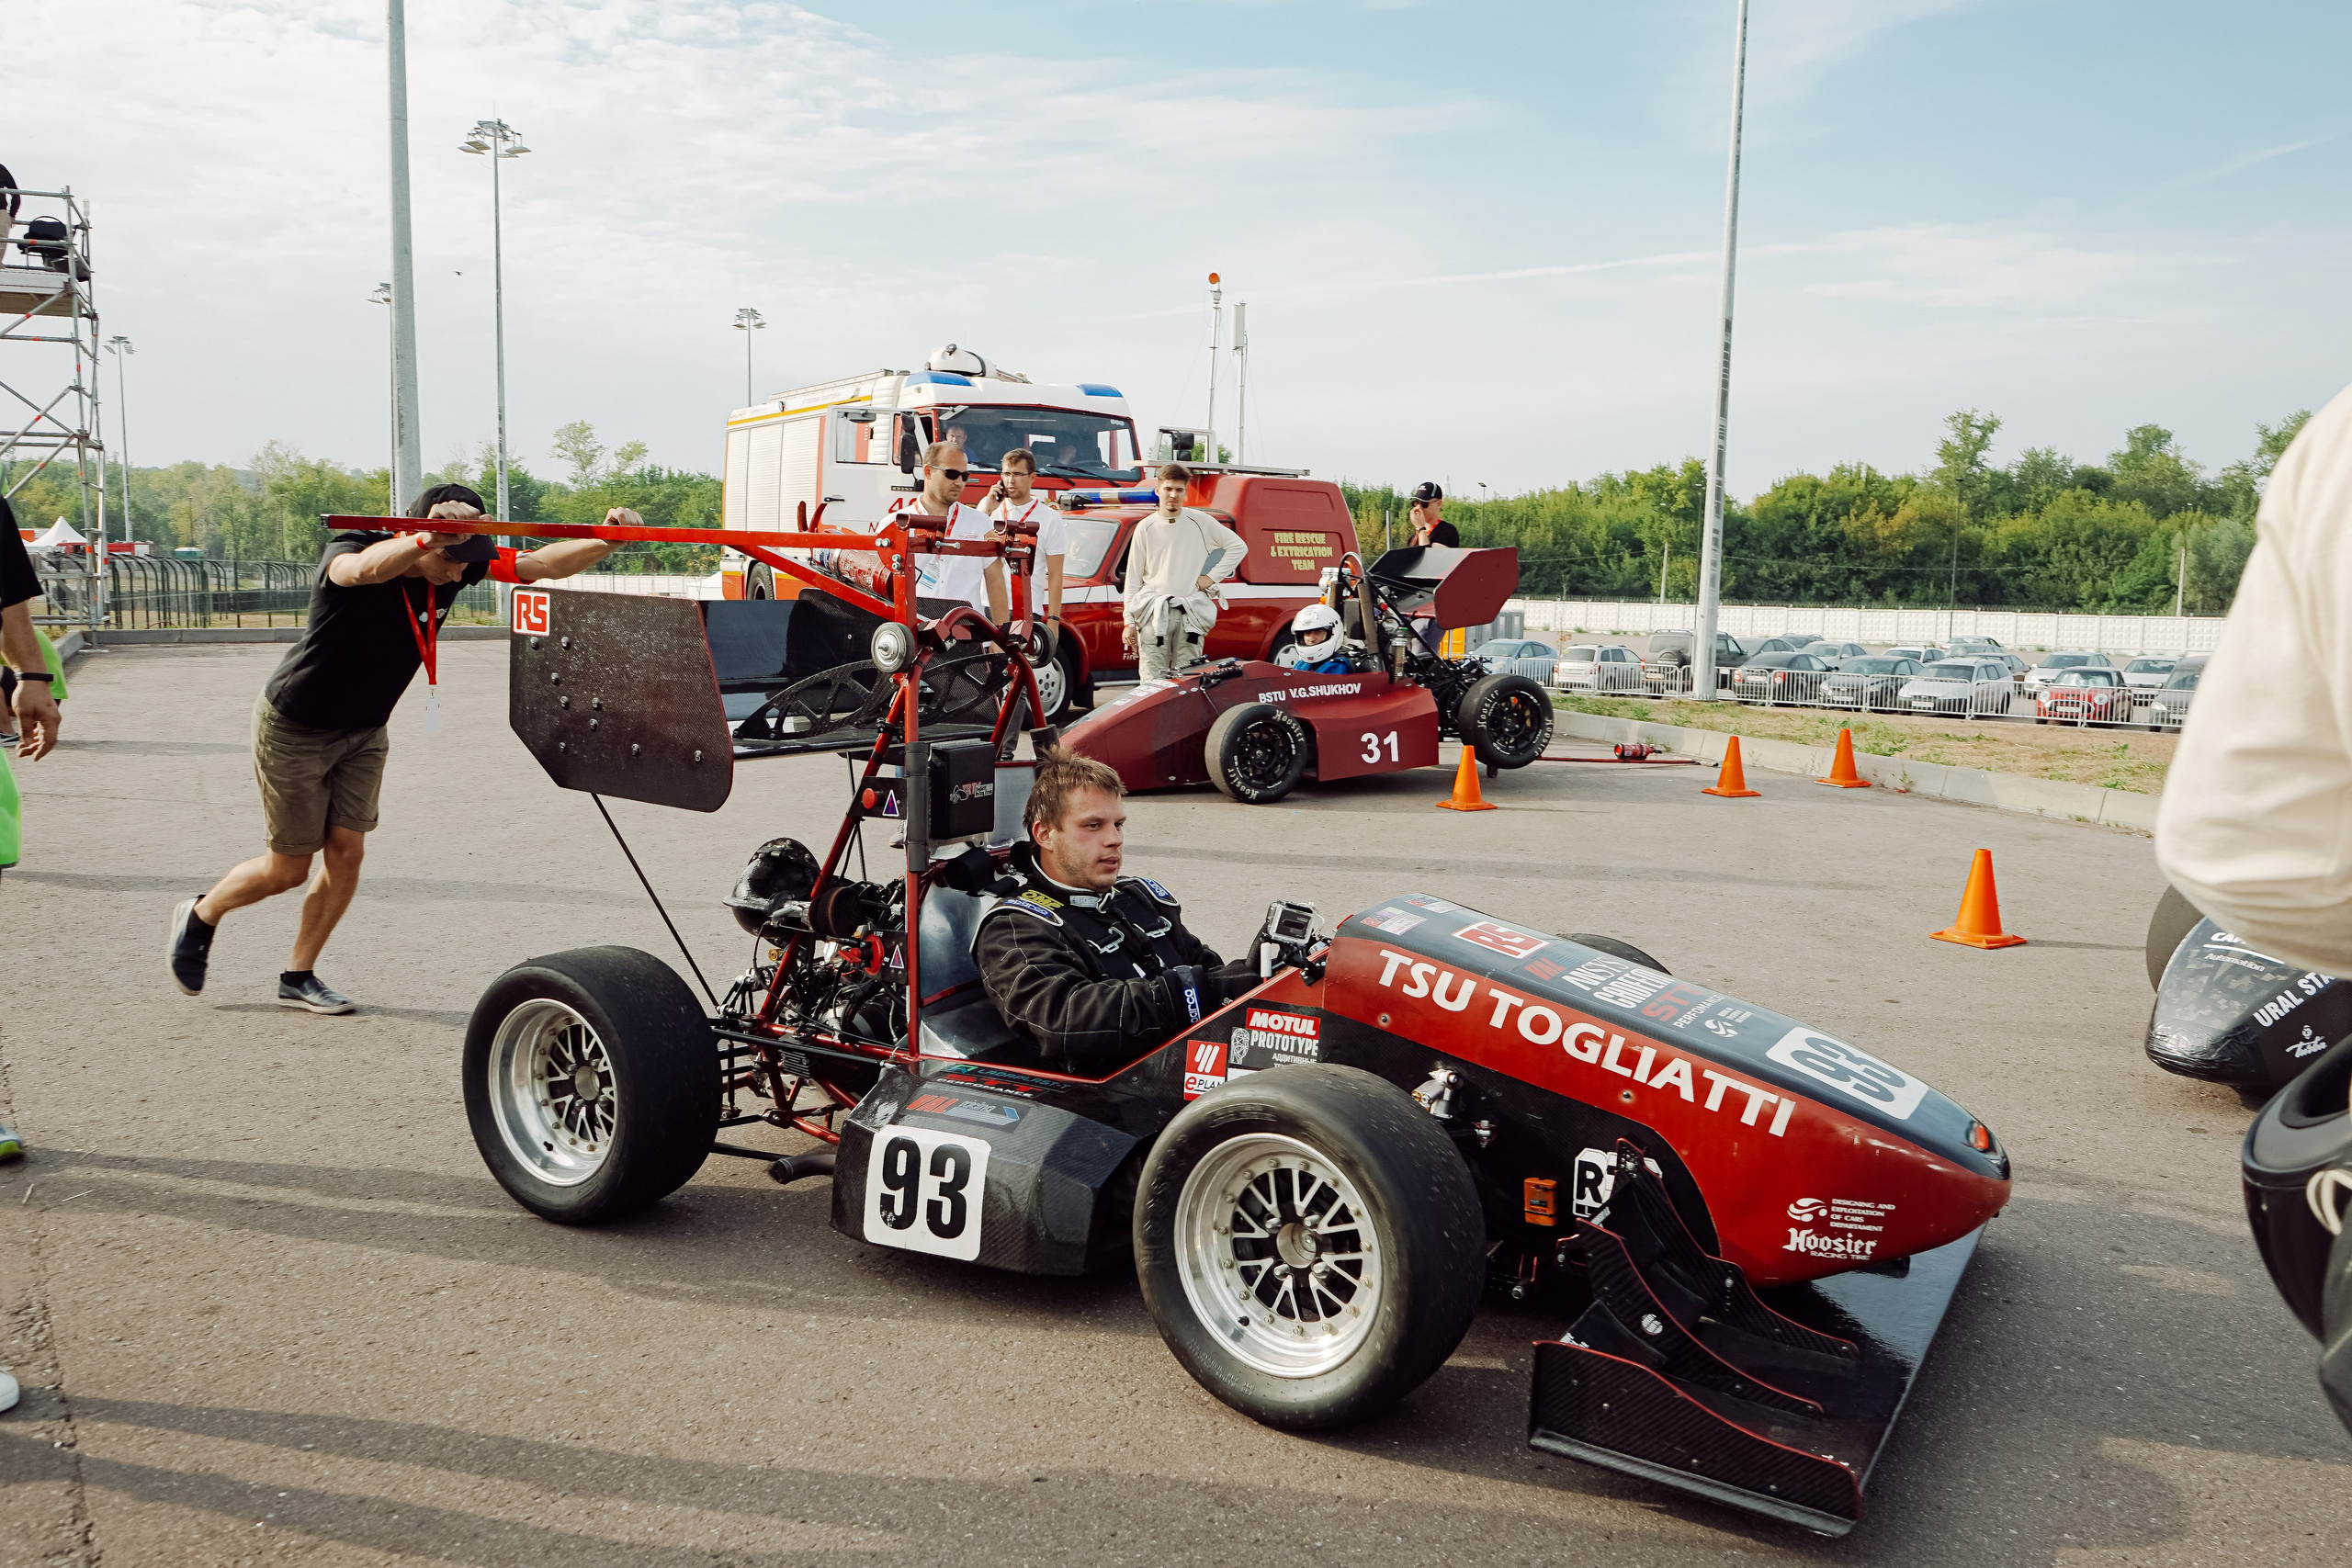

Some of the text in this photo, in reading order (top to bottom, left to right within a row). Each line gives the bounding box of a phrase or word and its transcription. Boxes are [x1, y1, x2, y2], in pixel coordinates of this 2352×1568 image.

[1274, 532, 1326, 544] FIRE RESCUE
[1270, 546, 1333, 557] & EXTRICATION
[1291, 559, 1316, 570] TEAM
[516, 593, 548, 633] RS
[1258, 682, 1362, 704] BSTU V.G.SHUKHOV
[1477, 689, 1499, 728] Hoosier
[1272, 709, 1305, 742] Hoosier
[1534, 717, 1554, 756] Hoosier
[1360, 730, 1399, 764] 31
[1227, 767, 1260, 800] Hoosier
[1021, 891, 1063, 908] OMP
[1562, 956, 1630, 992] ANSYS
[2204, 953, 2266, 973] Automation
[1184, 988, 1198, 1023] parco
[2253, 989, 2305, 1028] URAL
[1249, 1010, 1317, 1036] MOTUL
[1250, 1030, 1319, 1056] PROTOTYPE
[1378, 949, 1796, 1138] TSU TOGLIATTI
[906, 1093, 959, 1114] VAL
[879, 1134, 972, 1240] 93
[1830, 1205, 1885, 1217] EXPLOITATION
[1831, 1198, 1875, 1209] DESIGNING
[1843, 1214, 1865, 1223] CARS
[1781, 1227, 1877, 1256] Hoosier
[1809, 1250, 1849, 1259] RACING
